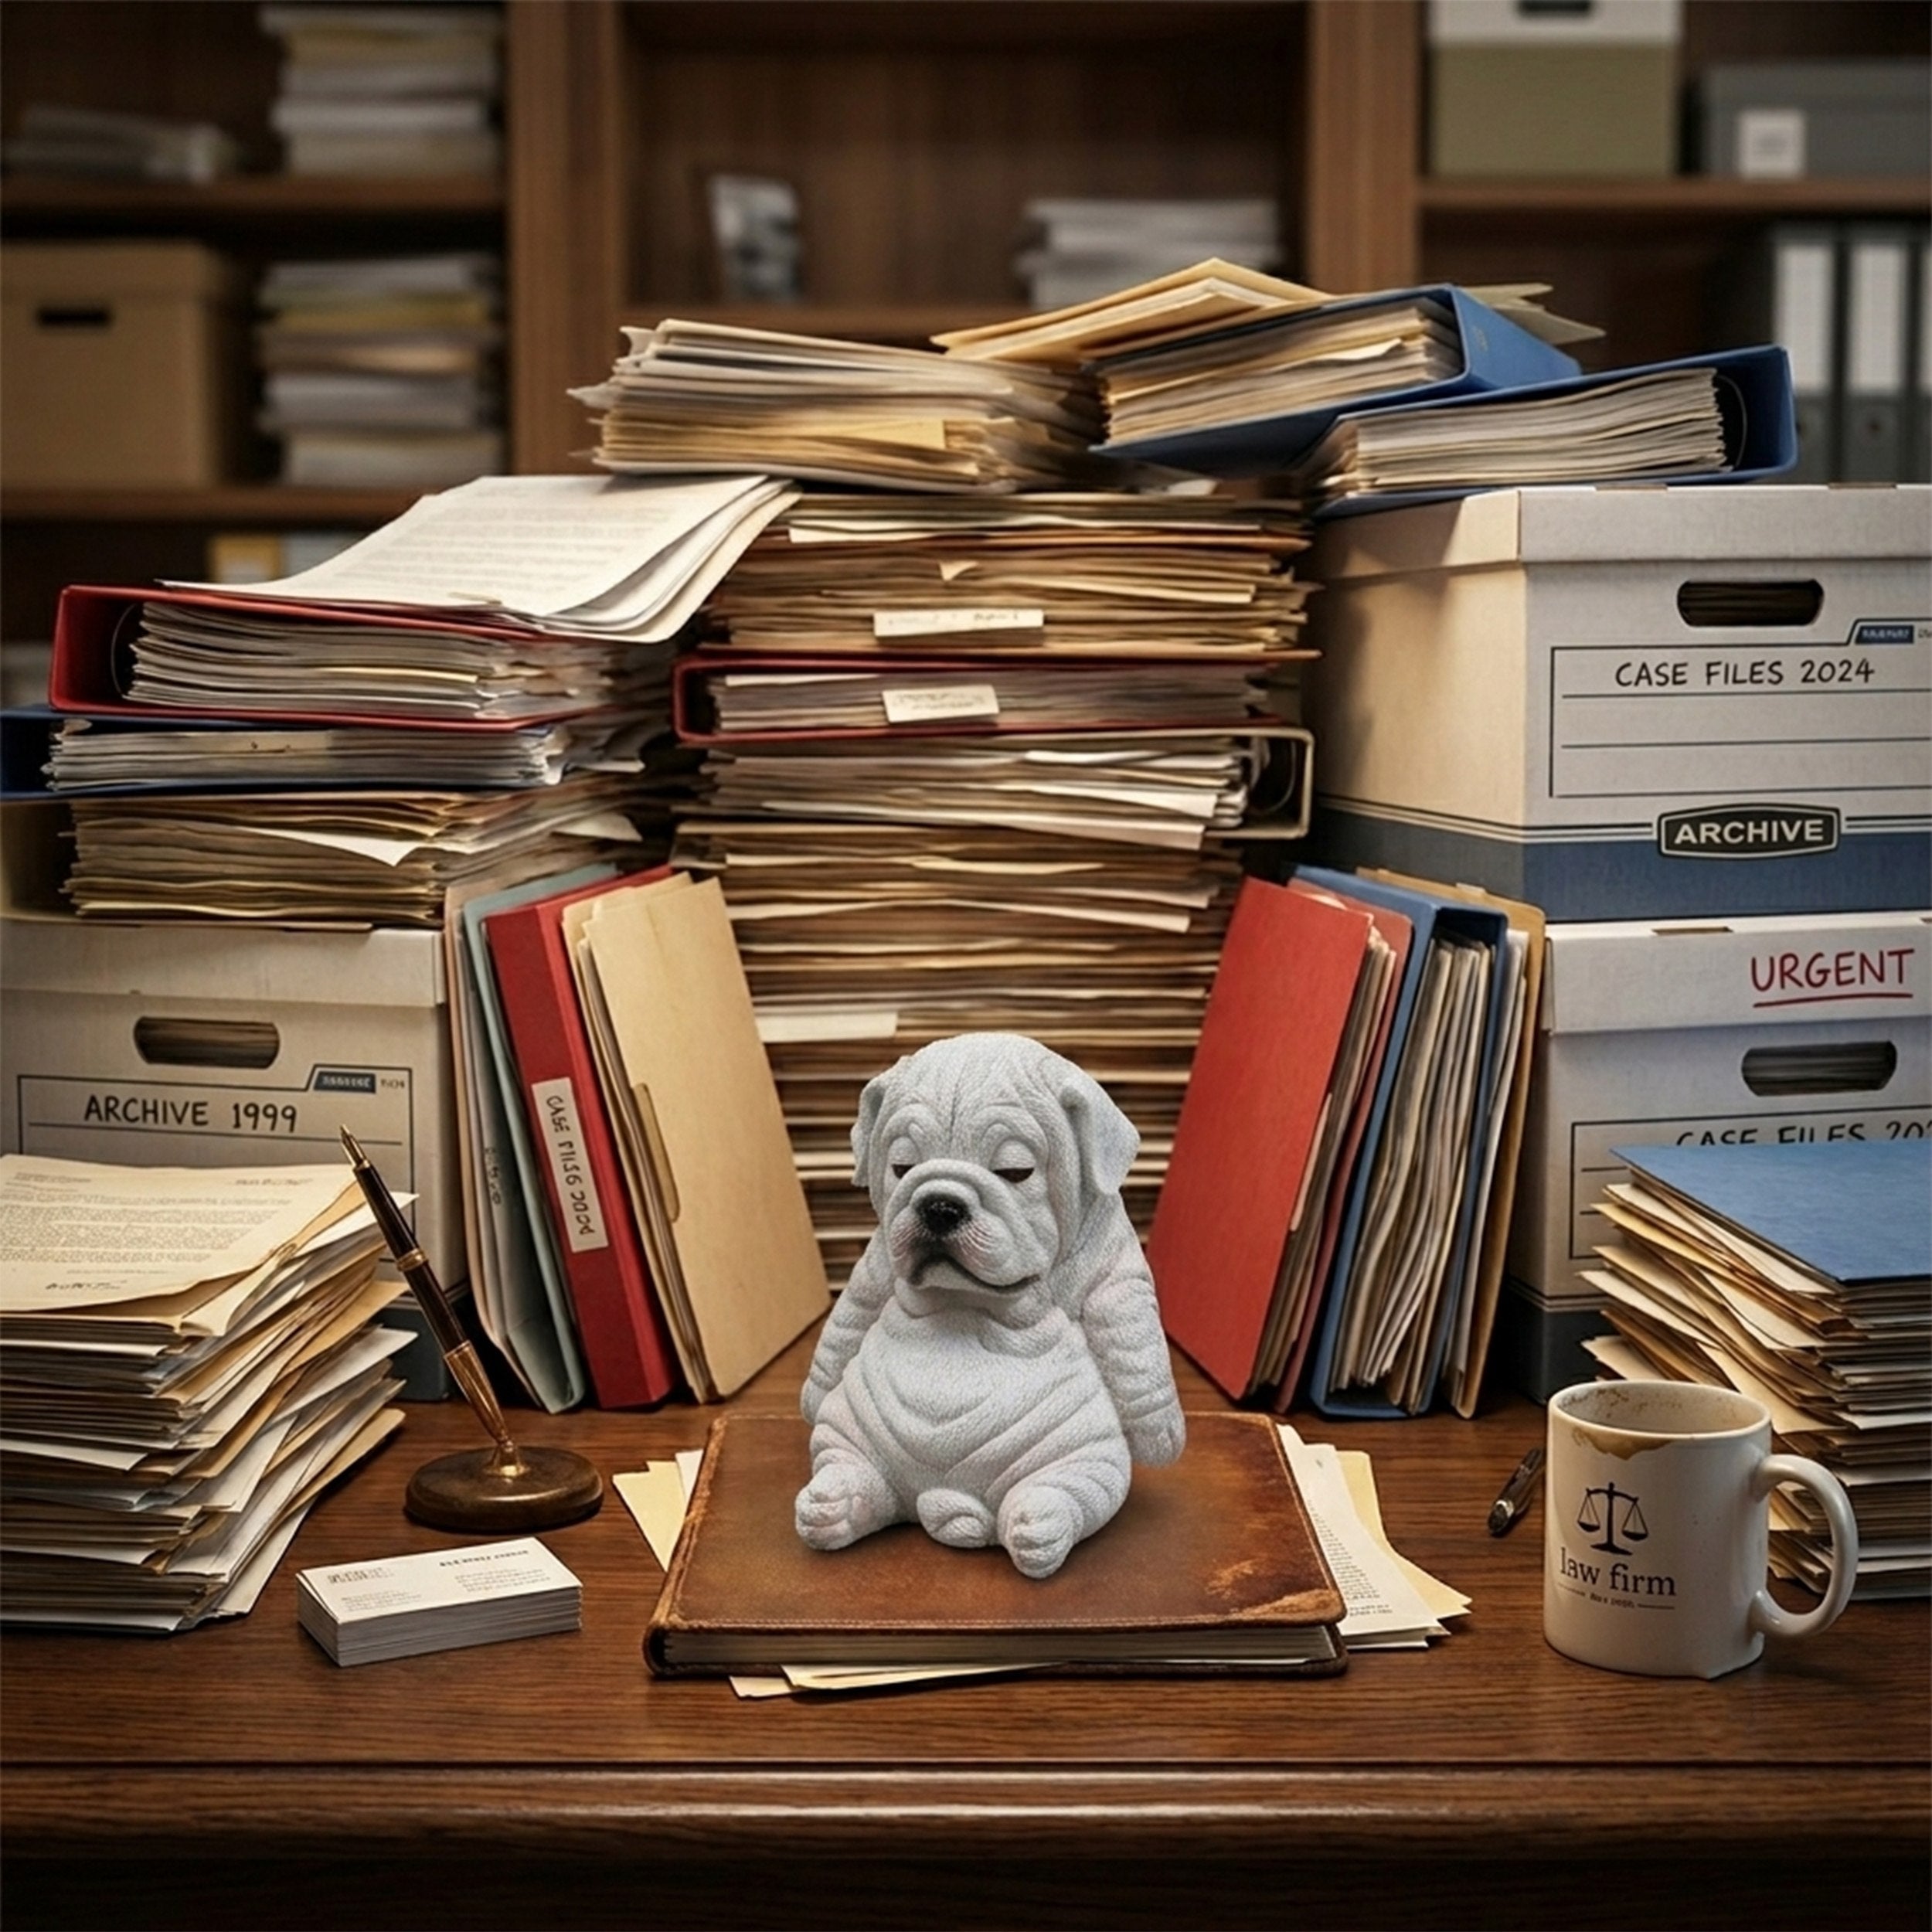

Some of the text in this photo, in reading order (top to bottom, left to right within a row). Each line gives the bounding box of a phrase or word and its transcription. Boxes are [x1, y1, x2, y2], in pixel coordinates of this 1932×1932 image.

[1615, 658, 1875, 687] CASE FILES 2024
[1674, 820, 1824, 845] ARCHIVE
[1751, 948, 1914, 992] URGENT
[83, 1094, 298, 1133] ARCHIVE 1999
[1560, 1546, 1676, 1596] law firm
